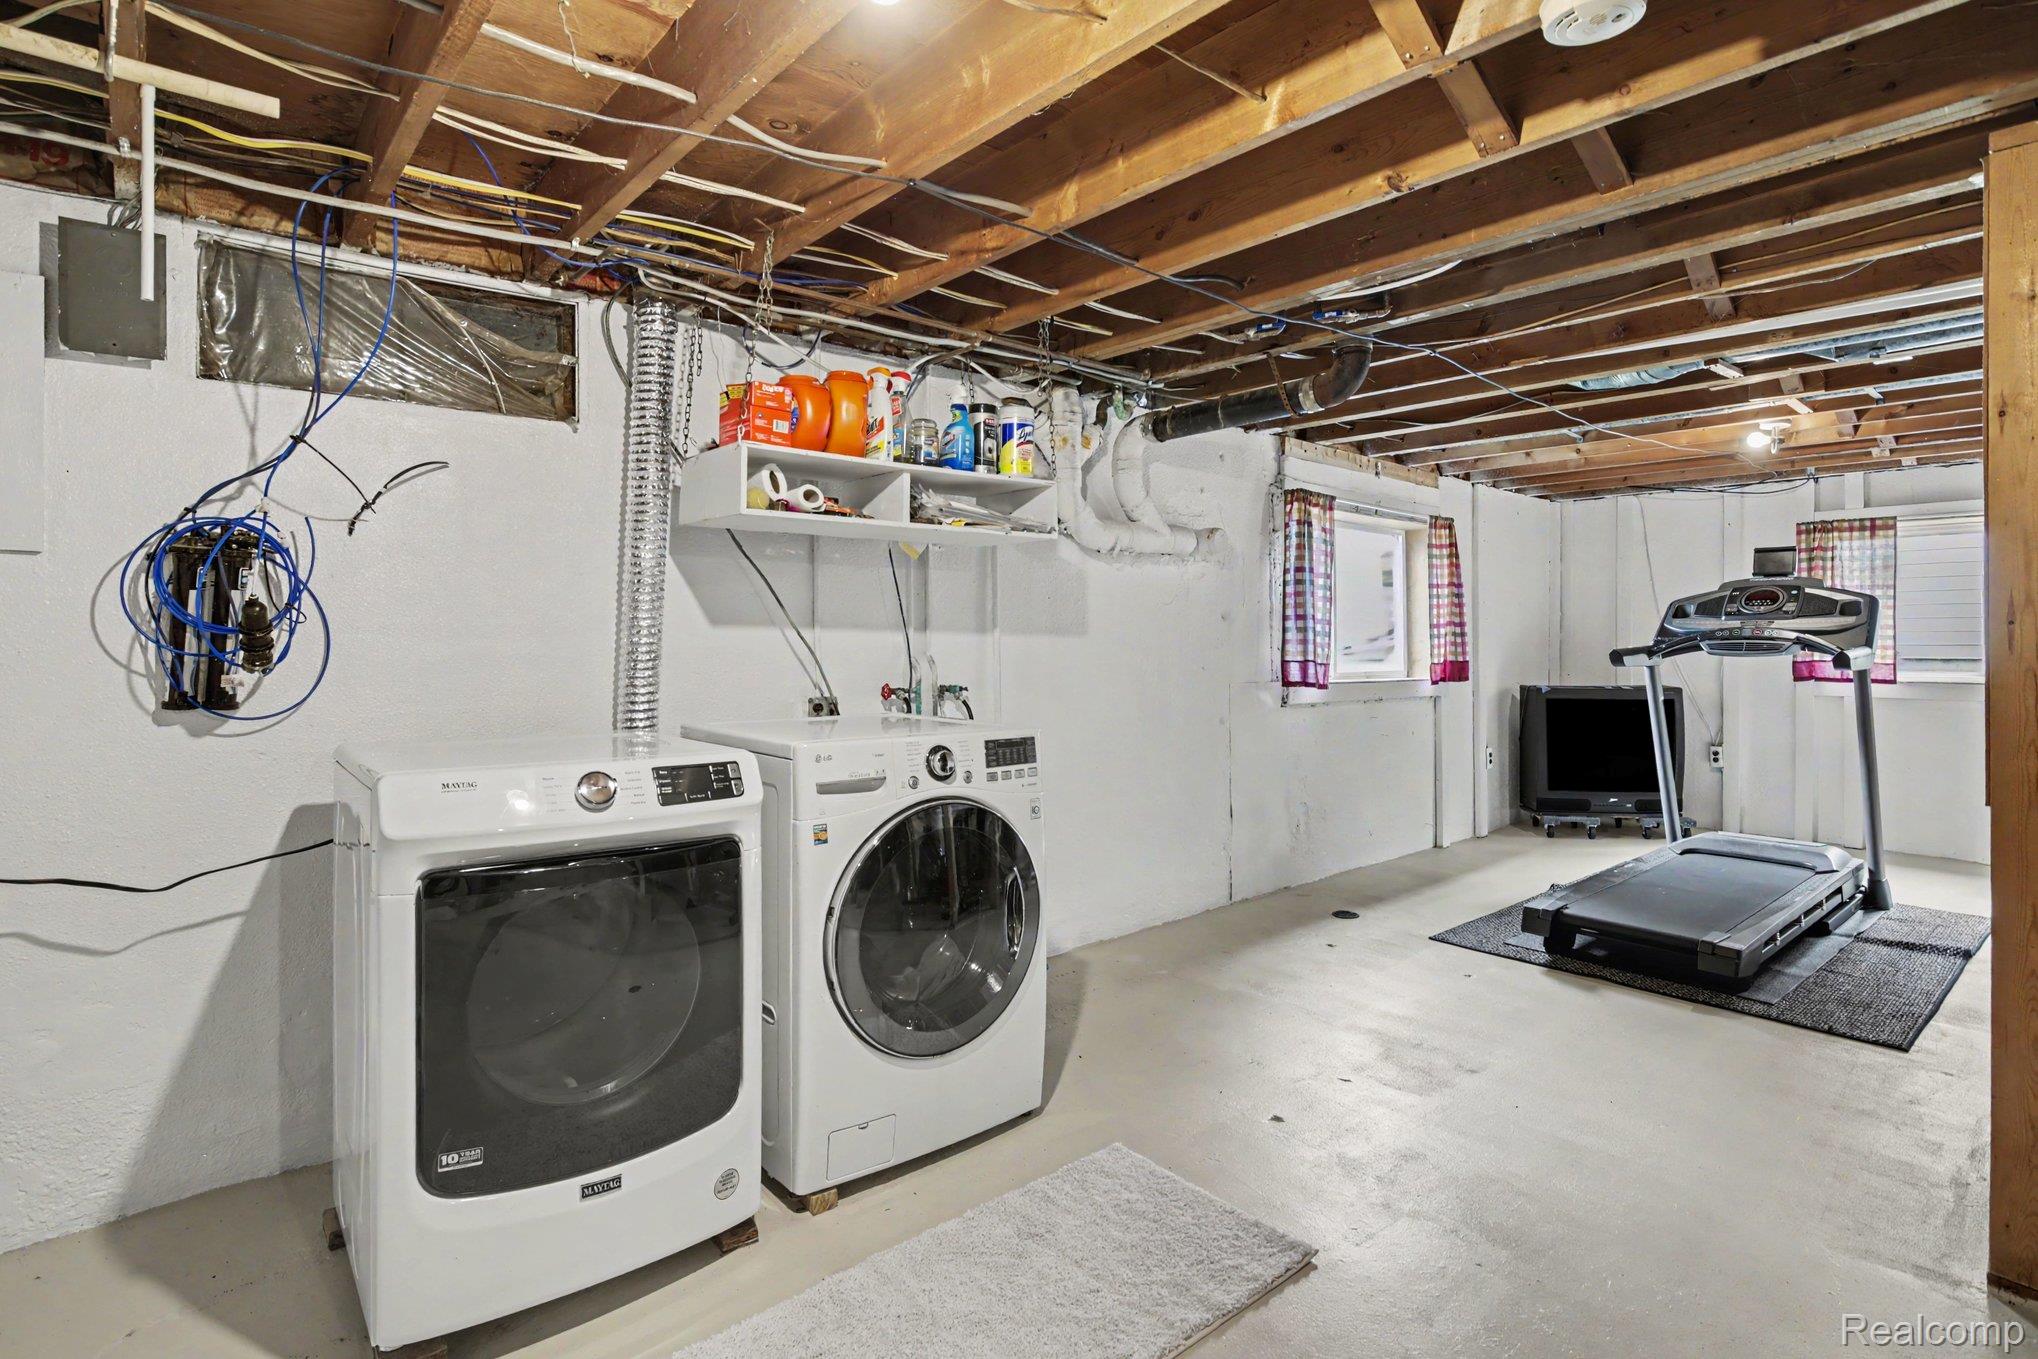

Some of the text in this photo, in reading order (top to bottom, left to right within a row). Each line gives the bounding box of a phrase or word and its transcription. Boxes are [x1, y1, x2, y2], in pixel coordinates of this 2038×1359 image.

[441, 781, 478, 789] MAYTAG
[441, 1153, 459, 1166] 10
[583, 1178, 620, 1197] MAYTAG
